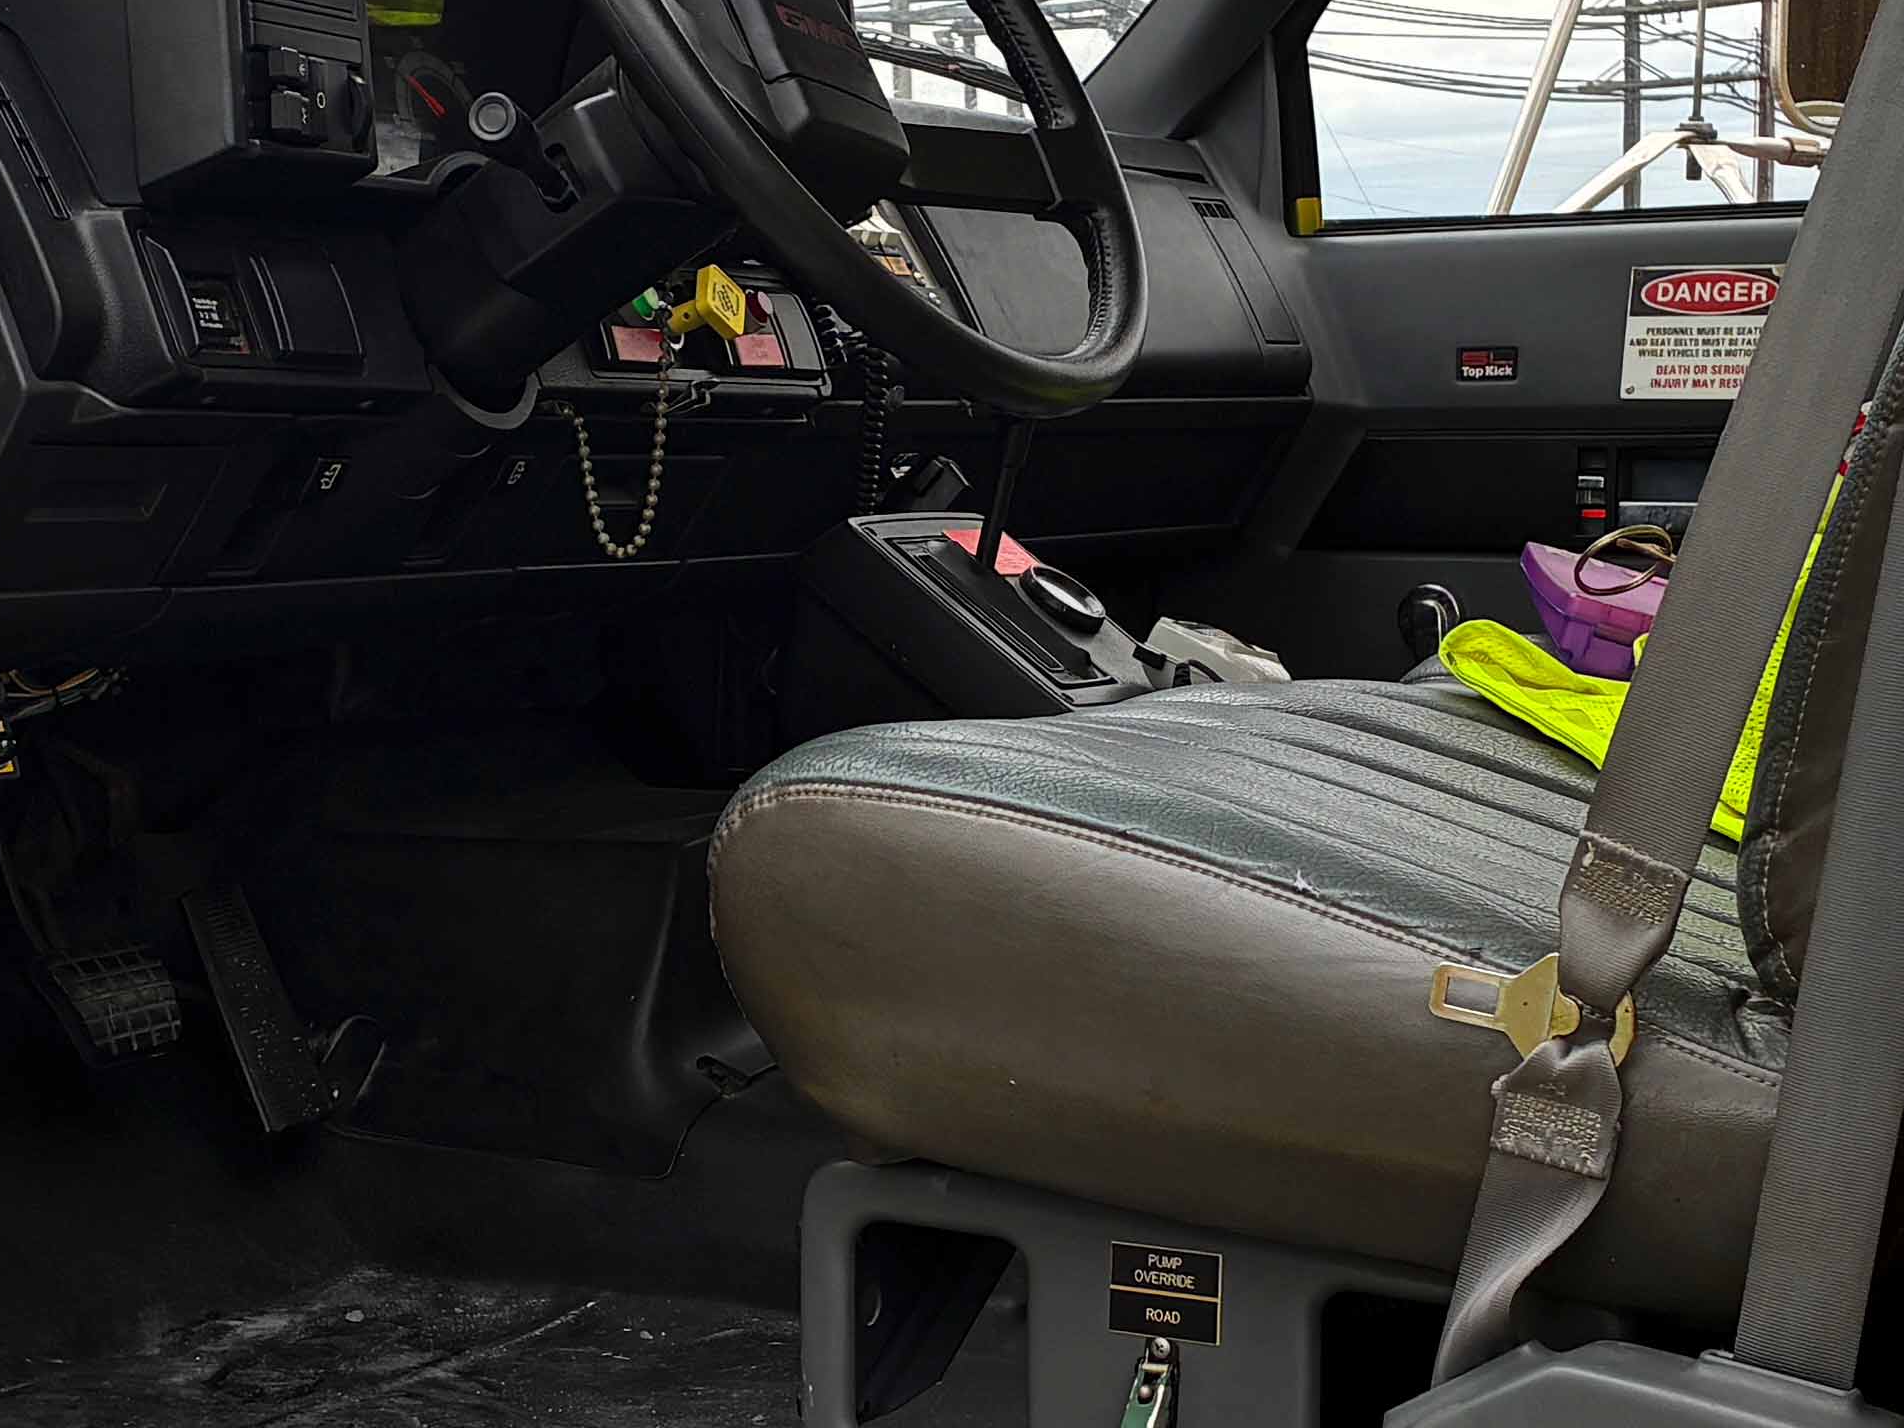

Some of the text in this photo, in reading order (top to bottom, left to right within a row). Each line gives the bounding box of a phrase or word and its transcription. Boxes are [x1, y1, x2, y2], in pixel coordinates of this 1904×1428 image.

[1656, 281, 1768, 303] DANGER
[1724, 349, 1753, 357] MOTIO
[1462, 365, 1513, 378] Top Kick
[1656, 365, 1691, 375] DEATH
[1694, 365, 1708, 375] OR
[1650, 378, 1688, 388] INJURY
[1691, 378, 1716, 388] MAY
[1148, 1253, 1182, 1269] PUMP
[1134, 1269, 1195, 1289] OVERRIDE
[1145, 1307, 1181, 1324] ROAD
